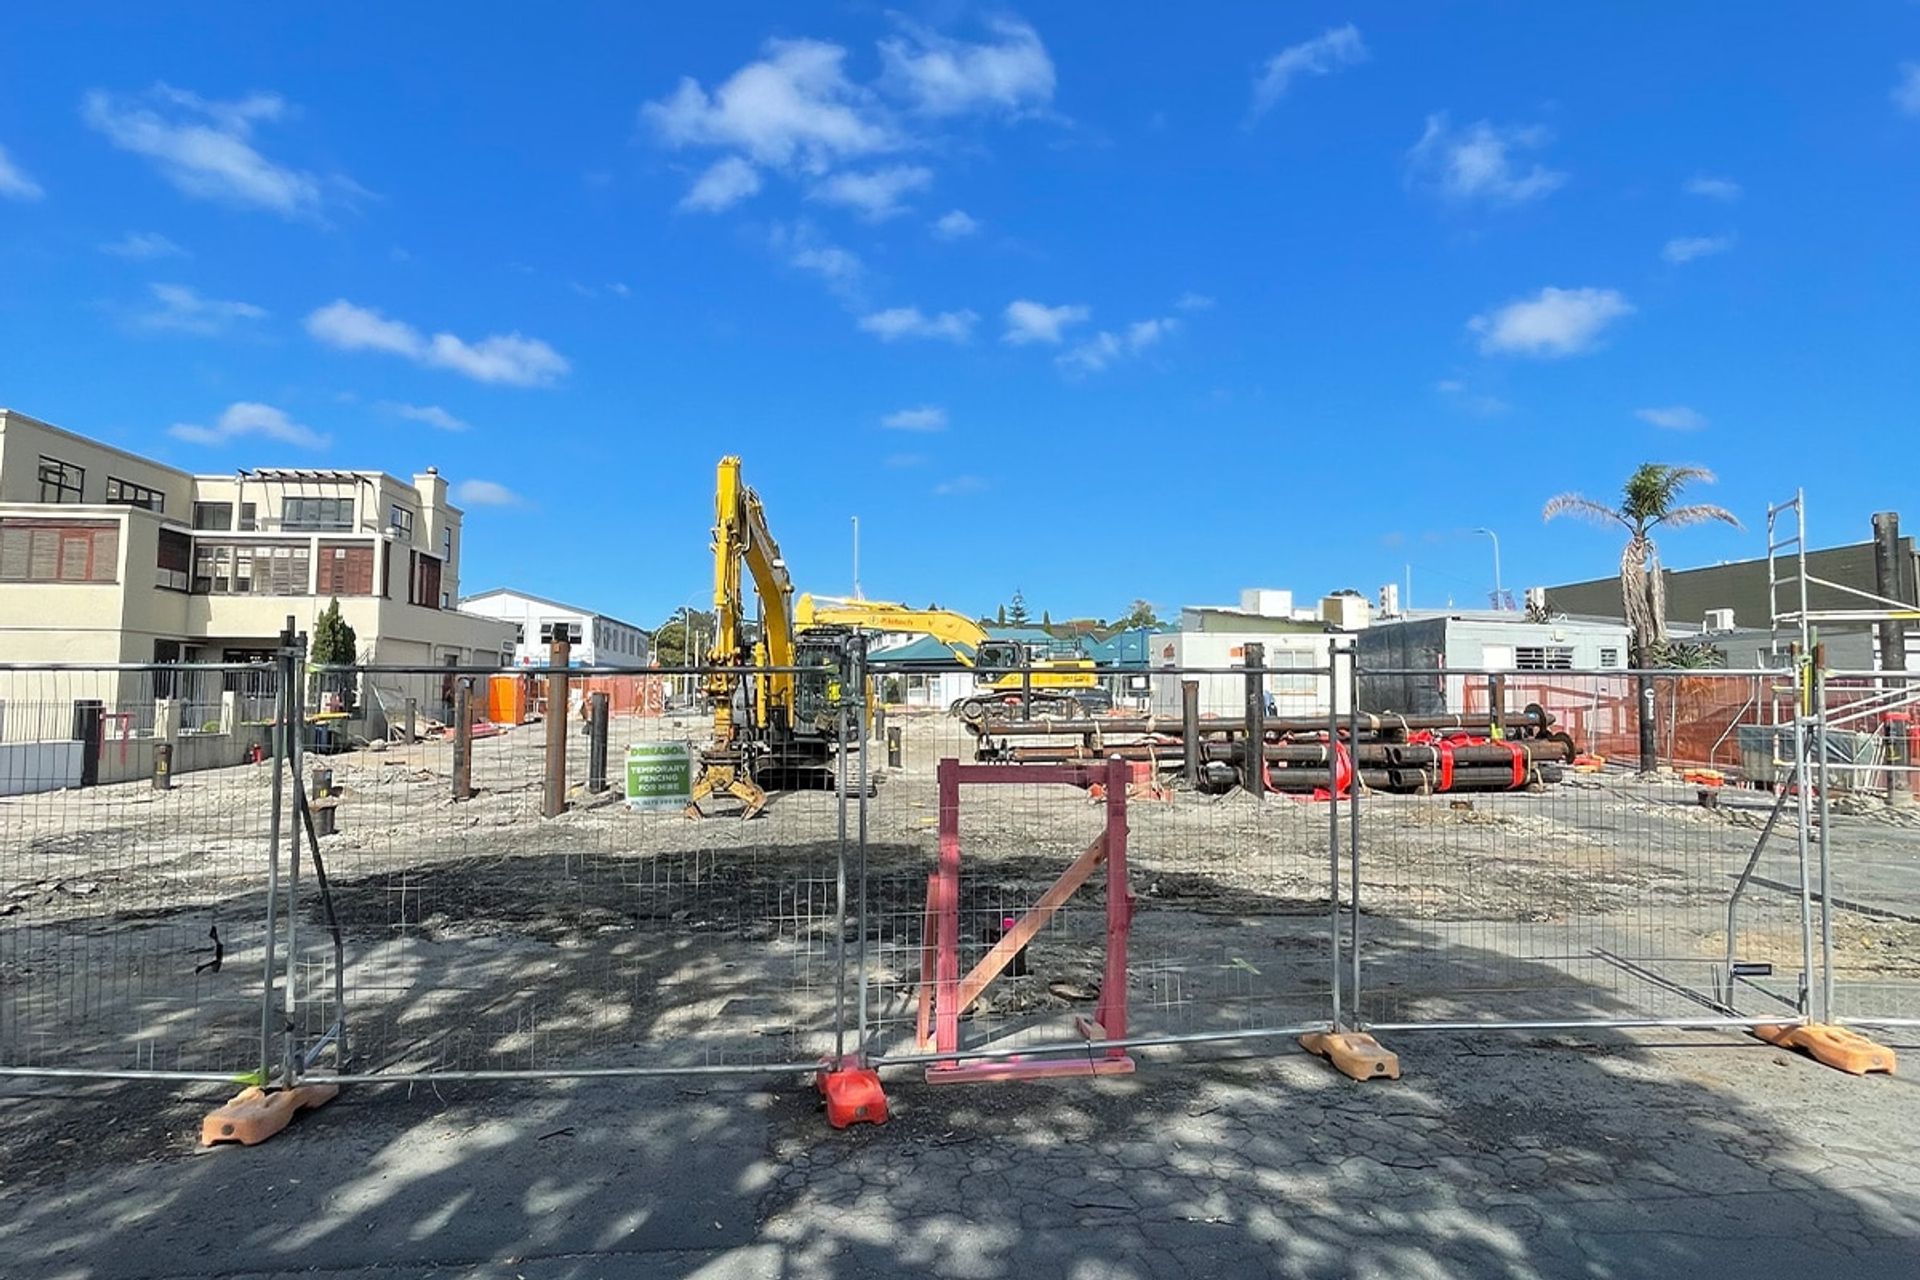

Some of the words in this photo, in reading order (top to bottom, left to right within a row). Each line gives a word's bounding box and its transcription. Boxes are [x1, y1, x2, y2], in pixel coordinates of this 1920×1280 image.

[631, 765, 687, 774] TEMPORARY
[638, 774, 678, 783] FENCING
[638, 784, 657, 792] FOR
[658, 783, 680, 791] HIRE
